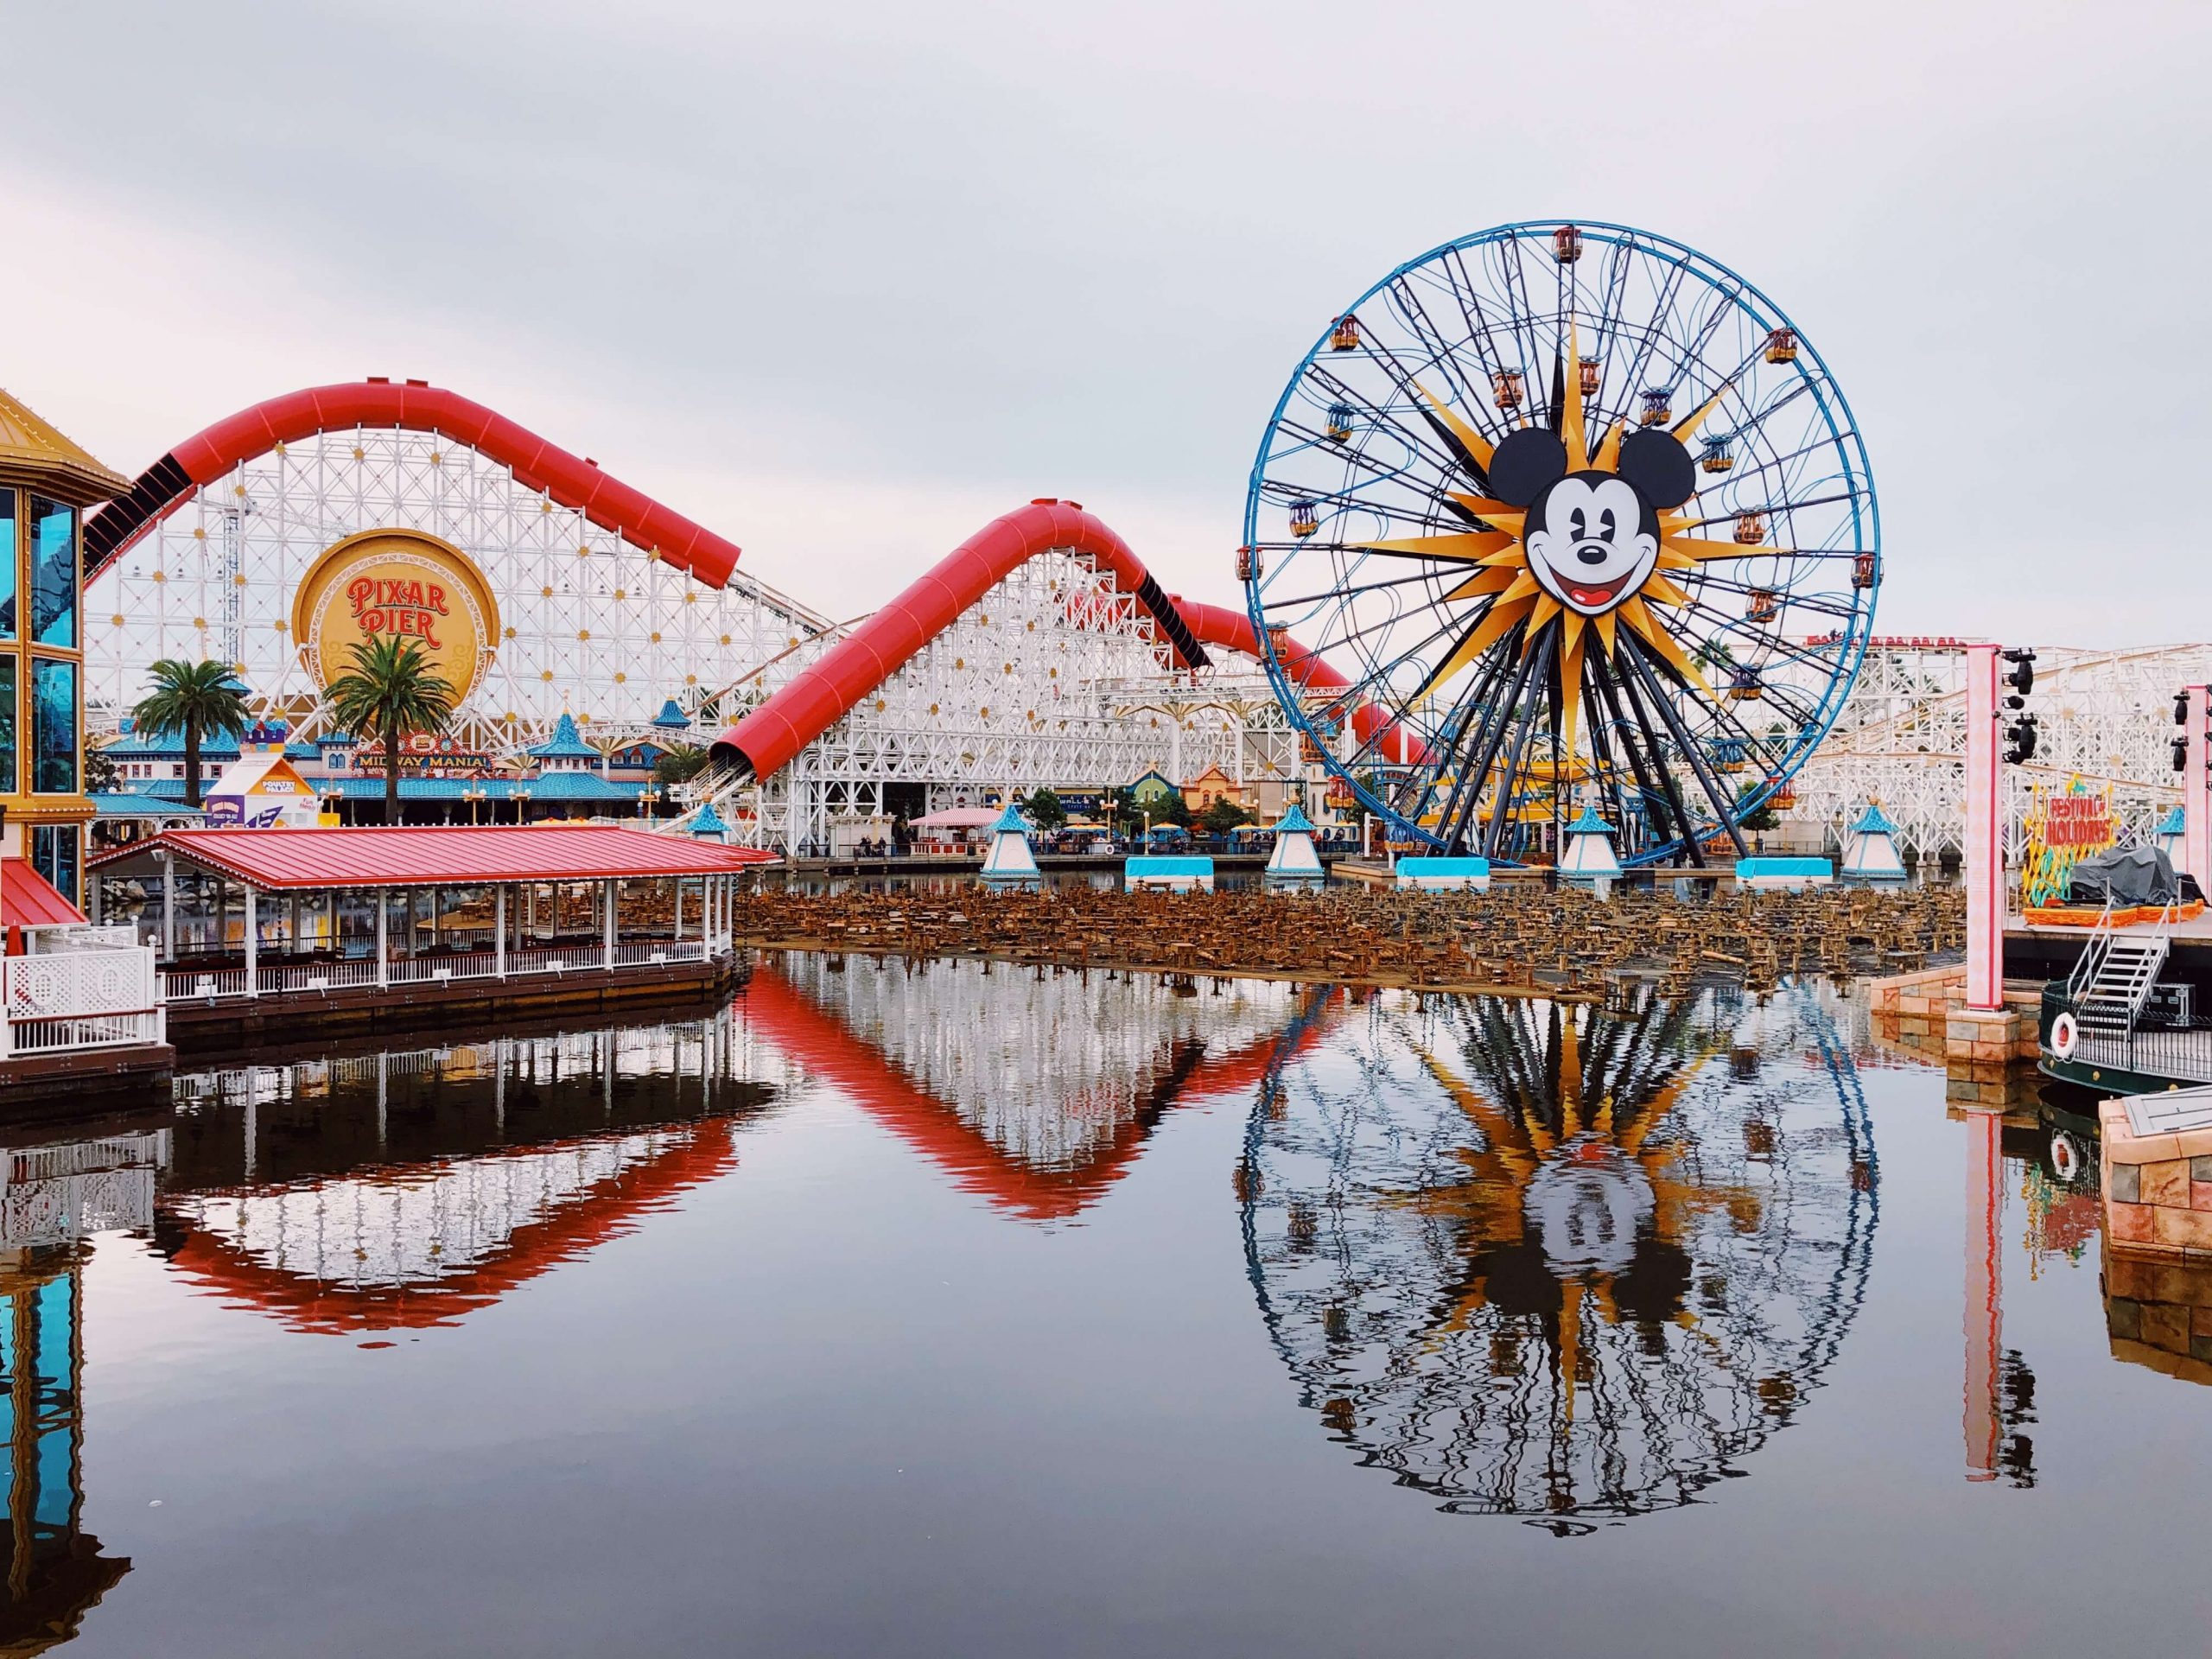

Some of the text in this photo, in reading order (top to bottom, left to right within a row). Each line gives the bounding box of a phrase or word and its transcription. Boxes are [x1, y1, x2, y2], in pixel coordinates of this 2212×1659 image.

[346, 576, 449, 617] PIXAR
[359, 607, 442, 649] PIER
[429, 756, 486, 766] MANIA!
[2051, 798, 2099, 817] FESTIVAL
[2047, 819, 2112, 846] HOLIDAYS
